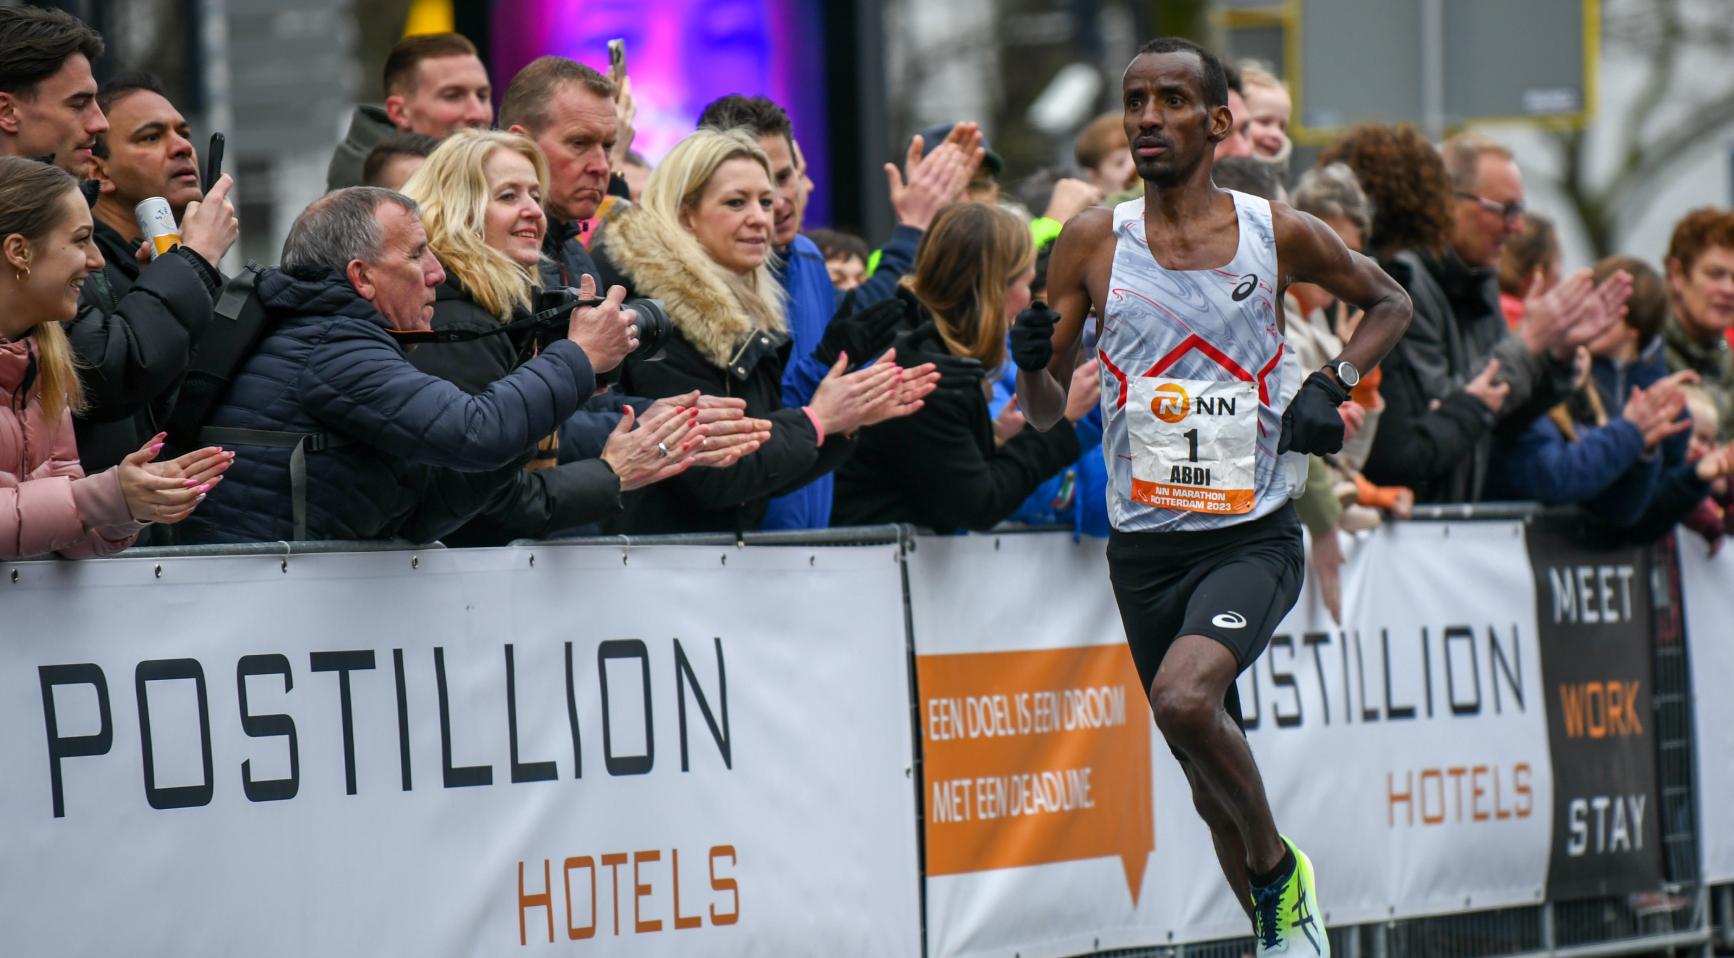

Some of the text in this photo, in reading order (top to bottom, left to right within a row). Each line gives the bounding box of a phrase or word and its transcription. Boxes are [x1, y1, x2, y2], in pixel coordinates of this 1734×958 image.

[1196, 396, 1236, 416] NN
[1183, 428, 1199, 463] 1
[1151, 495, 1231, 511] ROTTERDAM 2023
[1155, 486, 1226, 501] NN MARATHON
[1169, 465, 1211, 486] ABDI
[1549, 565, 1634, 625] MEET
[38, 637, 733, 818] POSTILLION
[929, 685, 1126, 741] EEN DOEL IS EEN DROOM
[1559, 680, 1643, 739] WORK
[932, 778, 972, 824] MET
[976, 775, 1008, 820] EEN
[1386, 762, 1534, 828] HOTELS
[1567, 794, 1647, 857] STAY
[518, 844, 740, 946] HOTELS
